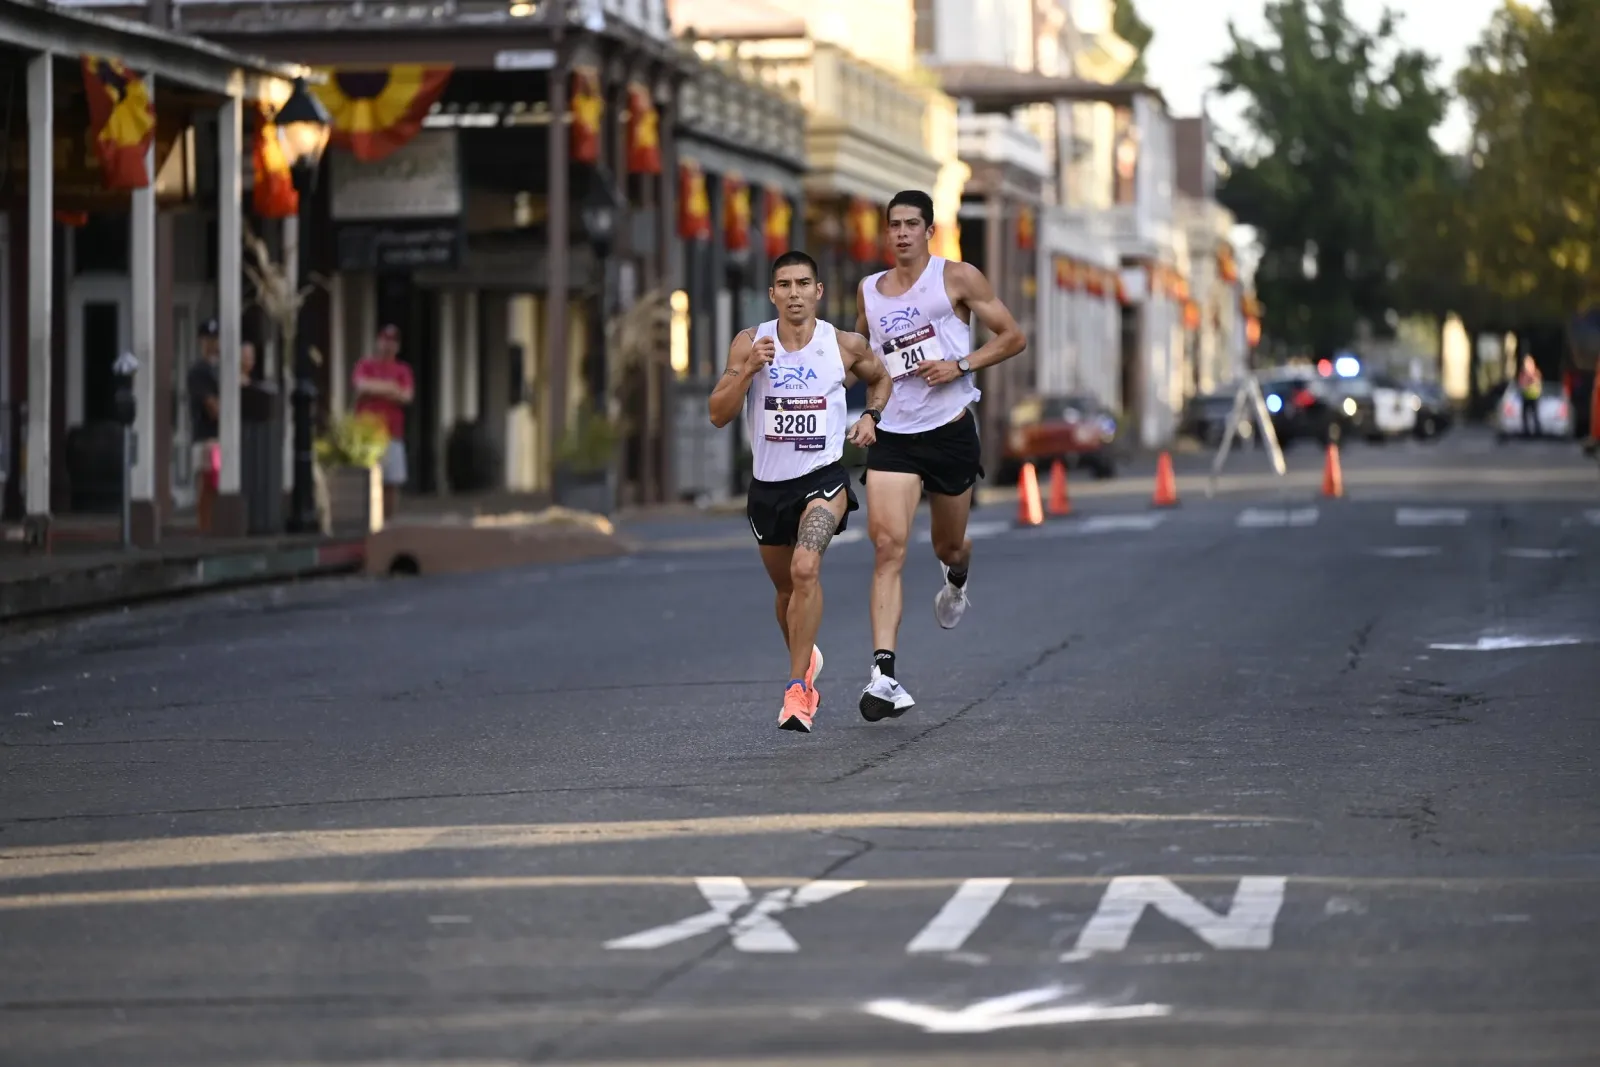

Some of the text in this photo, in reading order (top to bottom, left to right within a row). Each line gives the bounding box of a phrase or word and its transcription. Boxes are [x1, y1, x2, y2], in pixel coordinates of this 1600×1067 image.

[894, 323, 911, 332] ELITE
[901, 345, 926, 370] 241
[774, 414, 817, 434] 3280
